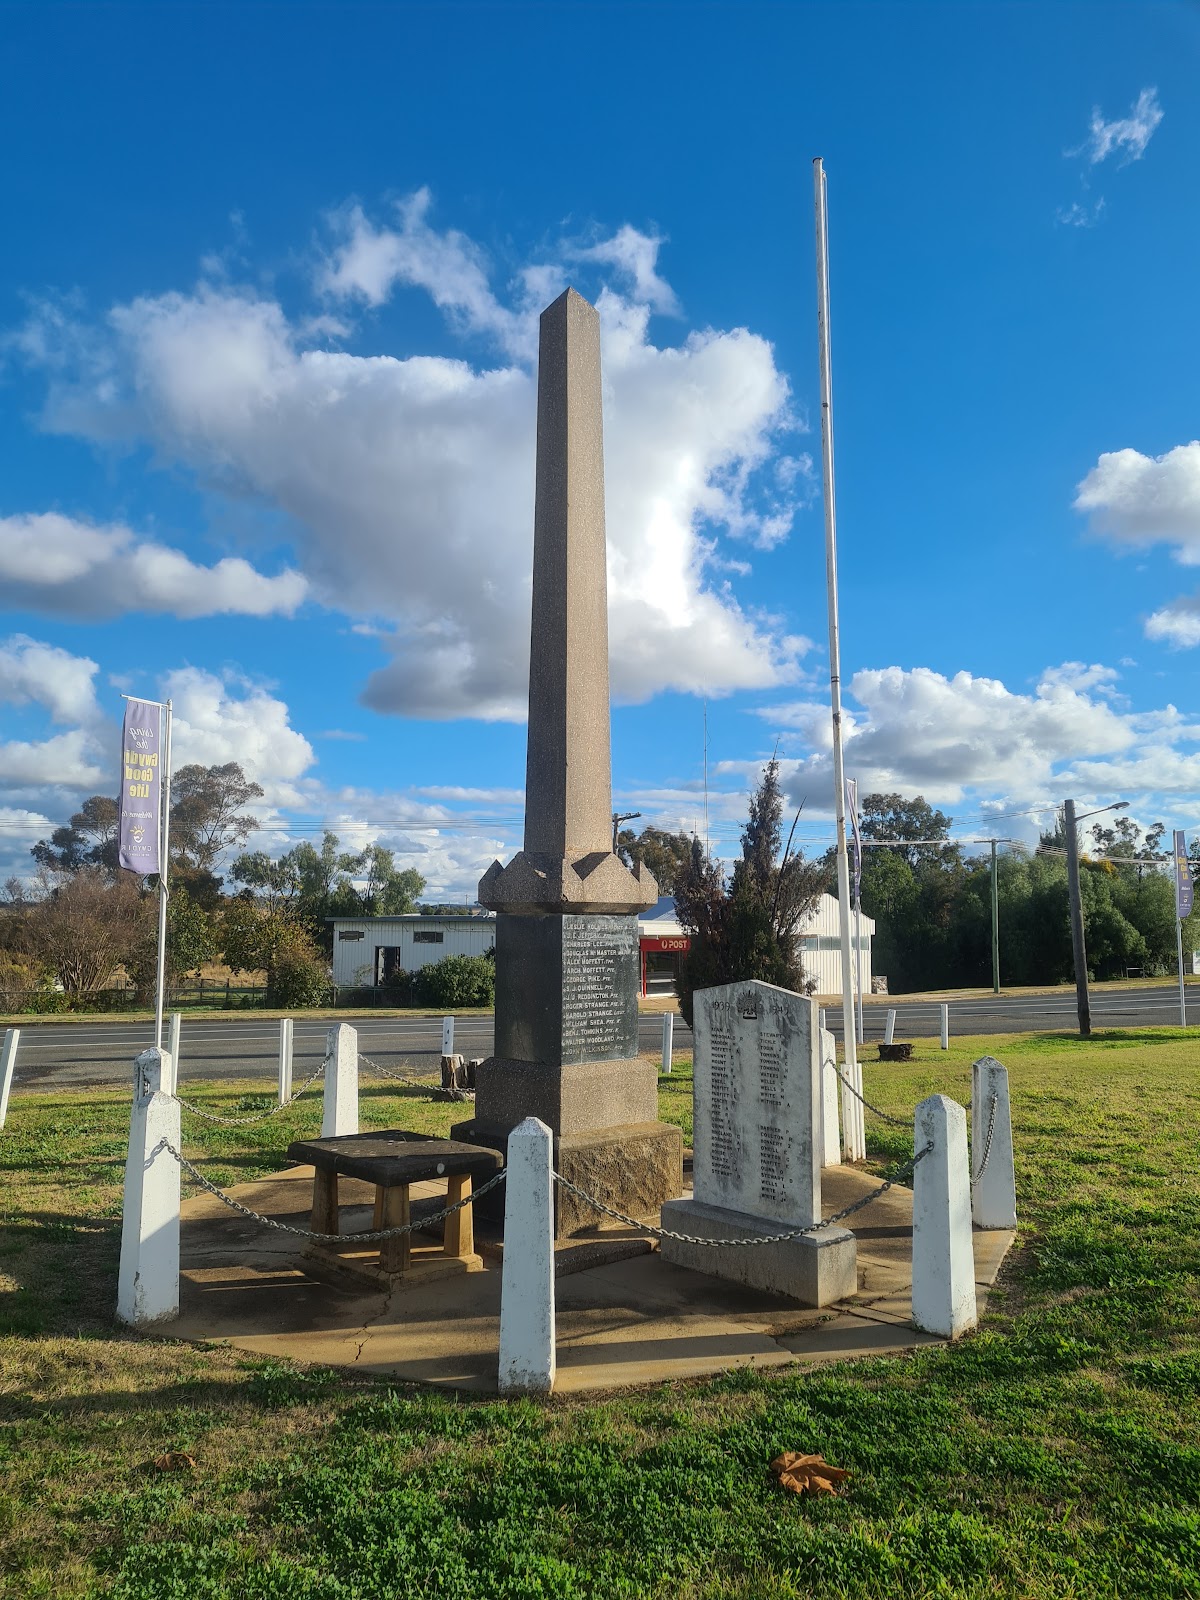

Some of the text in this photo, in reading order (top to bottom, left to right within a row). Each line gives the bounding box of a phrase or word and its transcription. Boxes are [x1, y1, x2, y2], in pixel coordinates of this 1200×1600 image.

[669, 940, 687, 948] POST
[712, 1001, 731, 1011] 1939
[711, 1162, 731, 1170] SIMPSON
[711, 1168, 733, 1176] STEWART
[761, 1172, 784, 1182] STEWART
